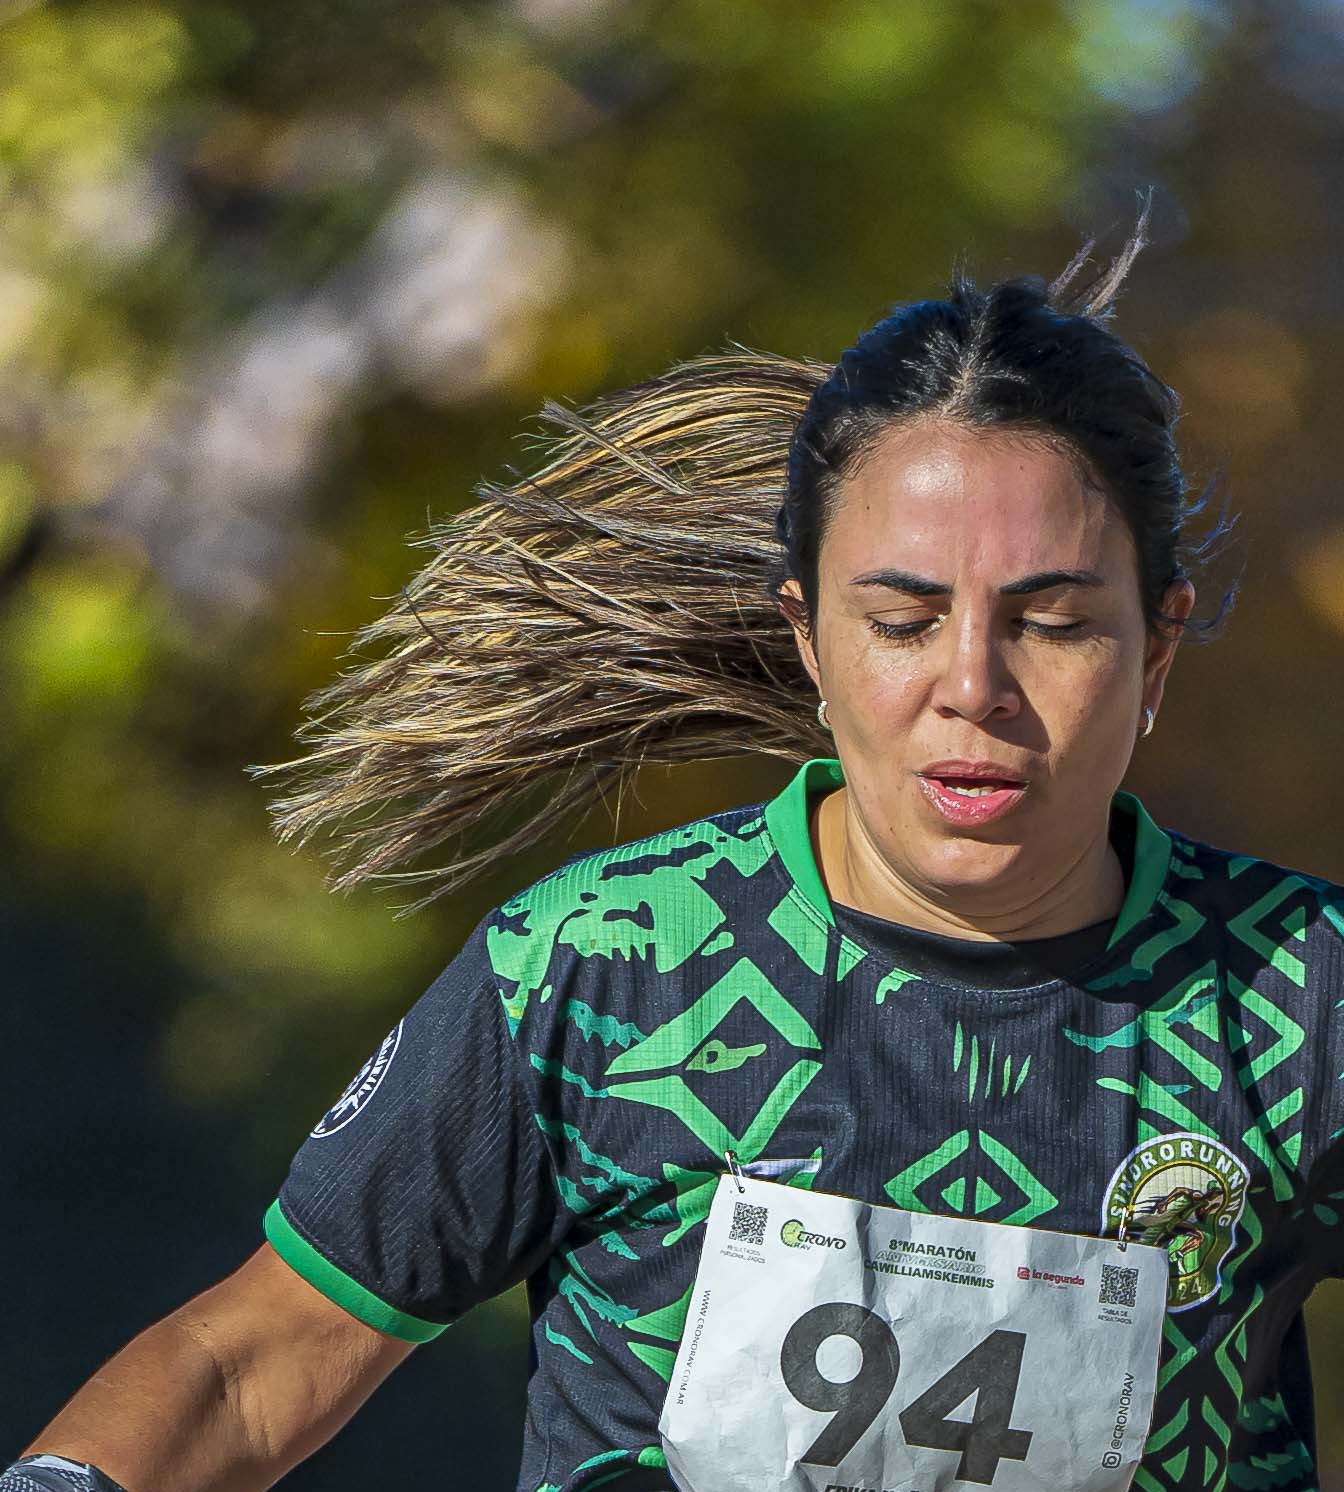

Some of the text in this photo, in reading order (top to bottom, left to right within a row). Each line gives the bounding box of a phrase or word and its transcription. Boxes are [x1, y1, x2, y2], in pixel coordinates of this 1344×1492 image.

[1032, 1269, 1042, 1280] la
[780, 1301, 1035, 1487] 94
[1110, 1372, 1135, 1450] @CRONORAV
